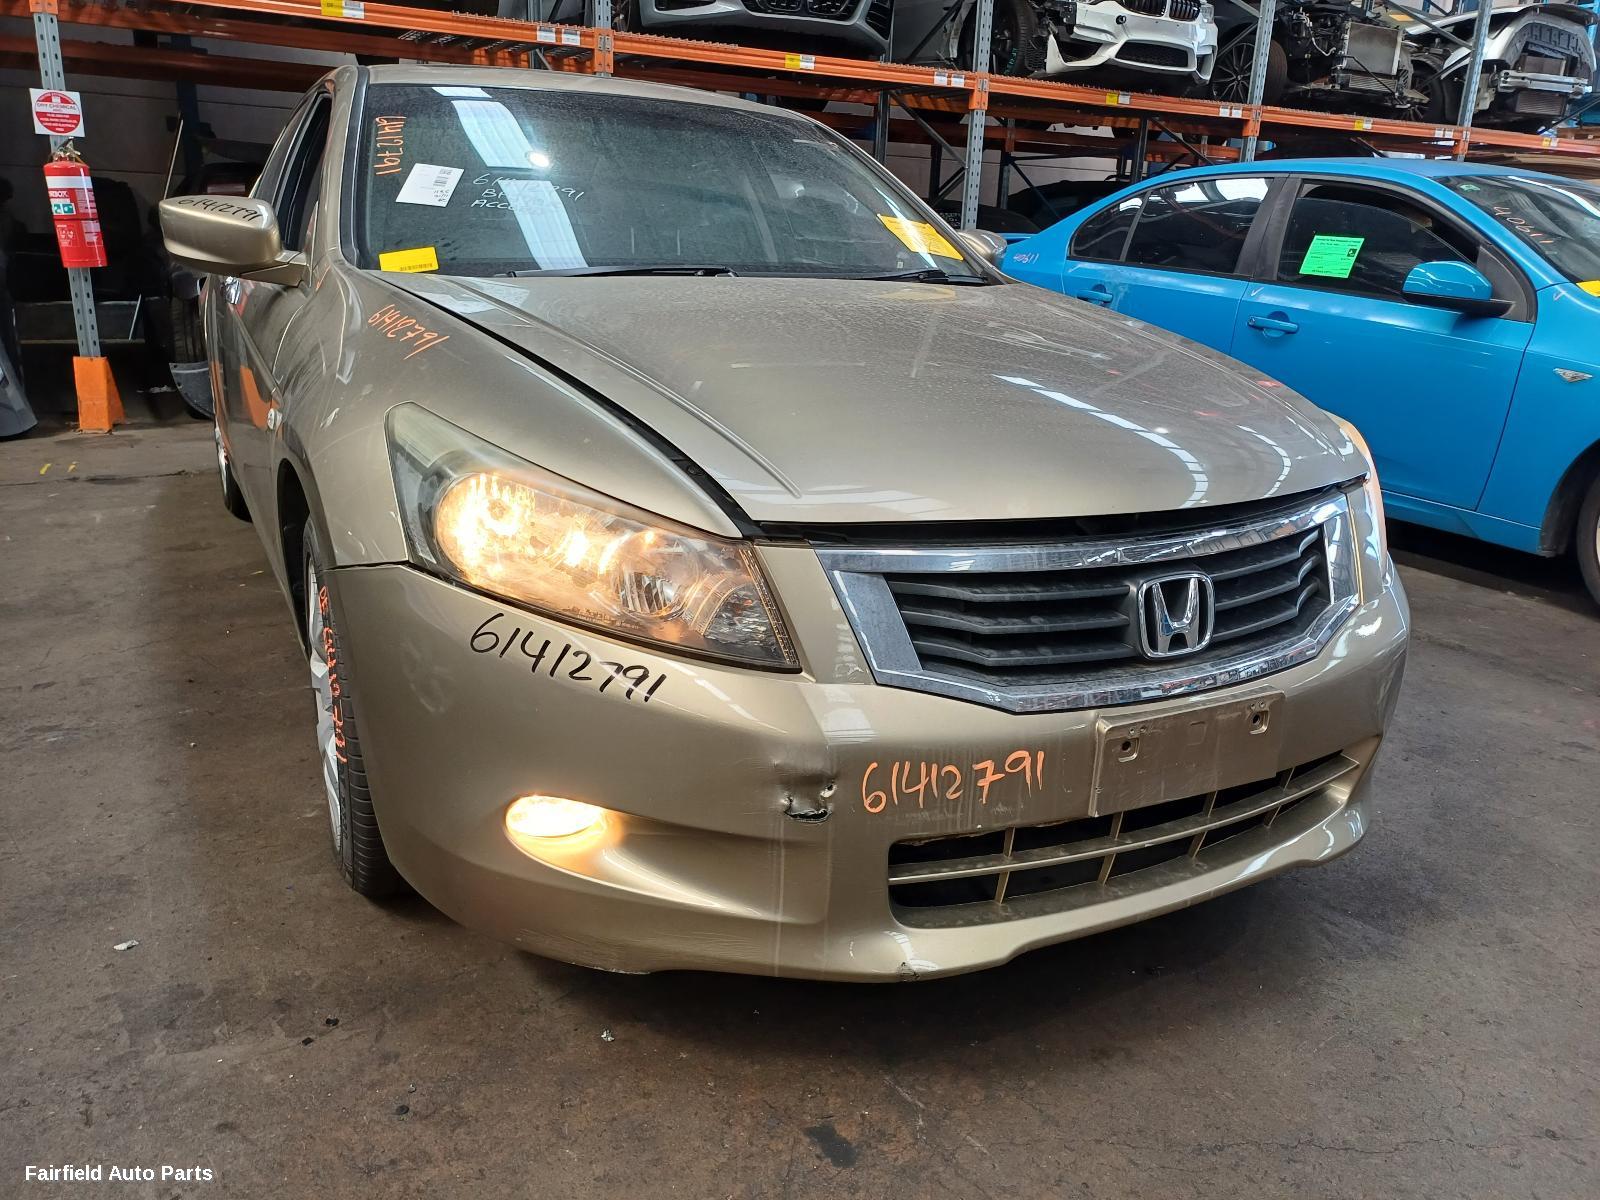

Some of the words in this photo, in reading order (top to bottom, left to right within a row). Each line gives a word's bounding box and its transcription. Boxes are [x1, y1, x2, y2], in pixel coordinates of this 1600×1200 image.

[374, 115, 406, 175] 61412791
[178, 198, 263, 222] 61412791
[367, 303, 450, 360] 61412791
[470, 612, 667, 703] 61412791
[862, 750, 1045, 814] 61412791
